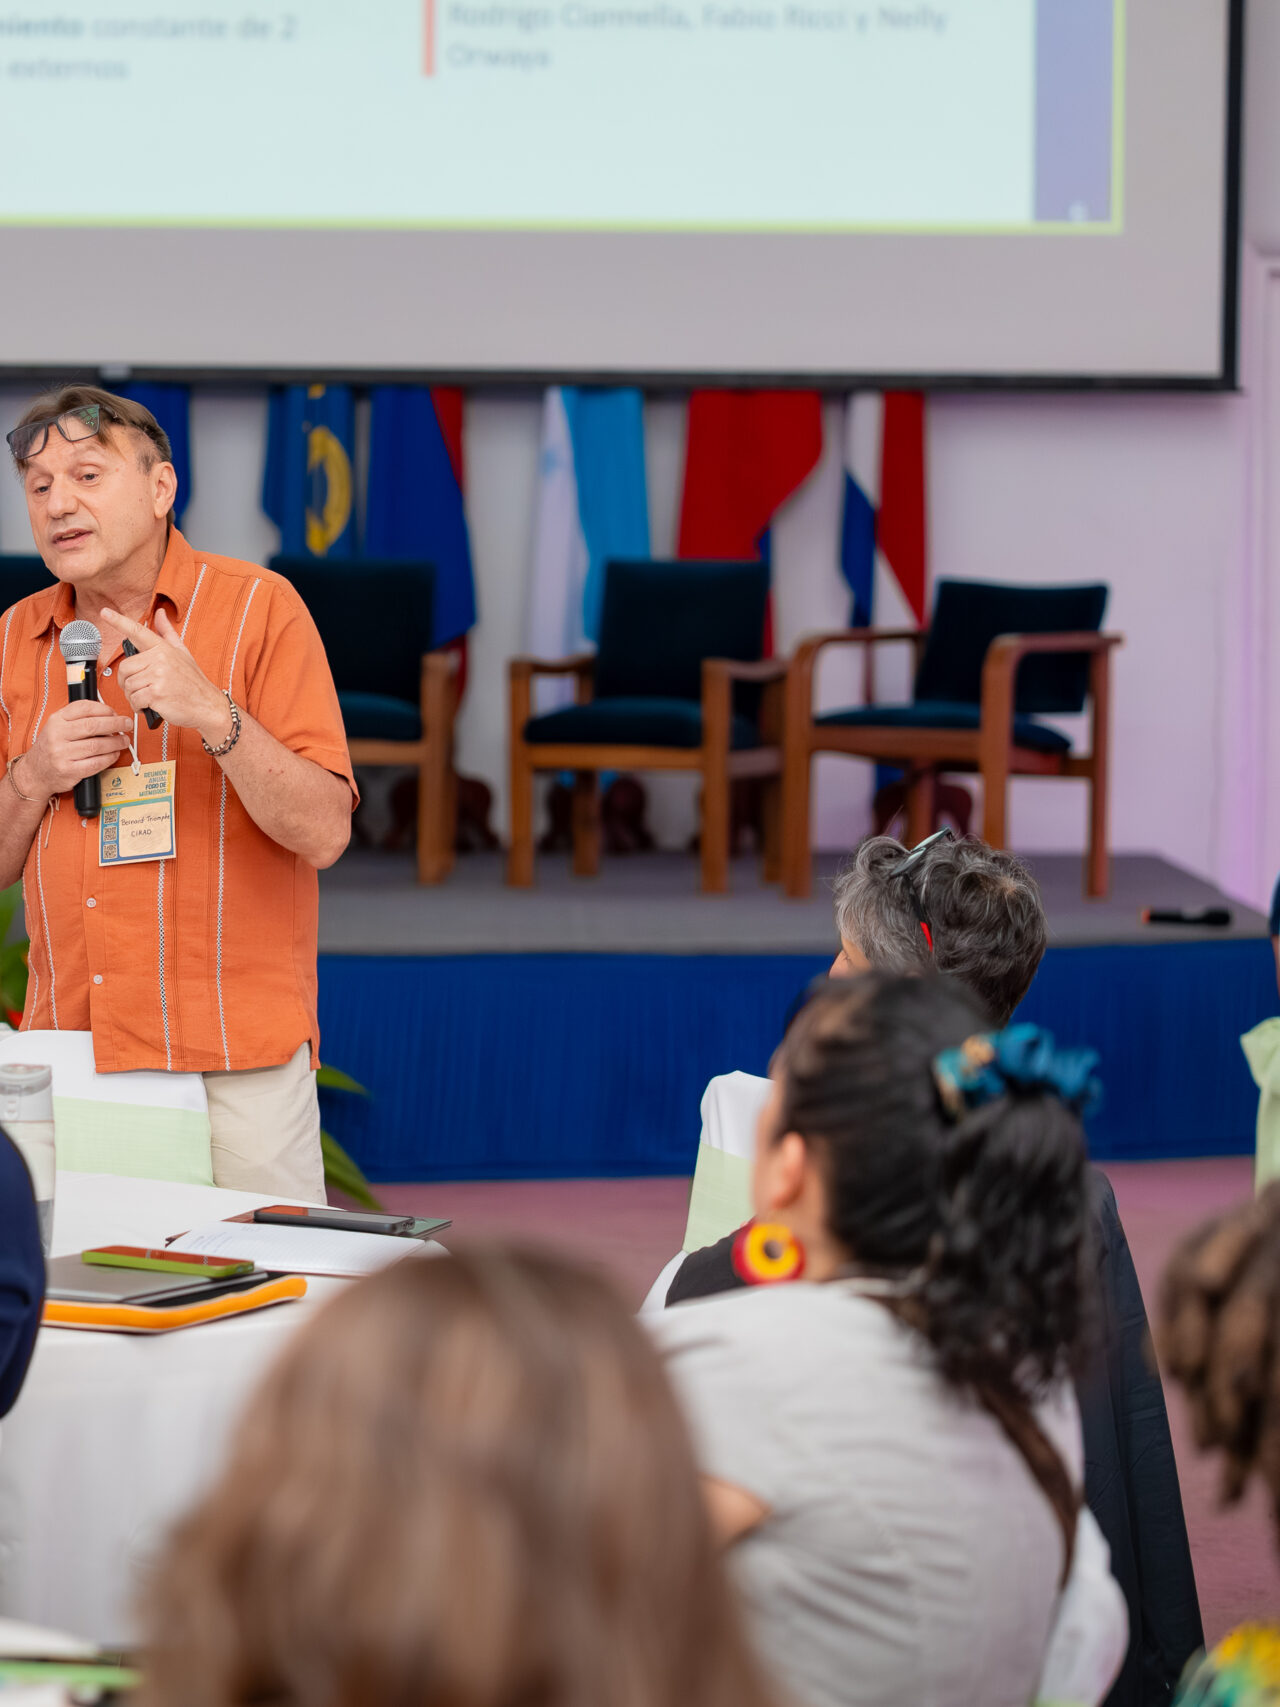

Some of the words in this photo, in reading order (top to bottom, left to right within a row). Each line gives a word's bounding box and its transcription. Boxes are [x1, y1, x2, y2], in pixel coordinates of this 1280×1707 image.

[92, 14, 228, 38] constante
[236, 12, 274, 39] de
[278, 12, 299, 41] 2
[855, 12, 868, 36] y
[8, 56, 131, 79] externos
[144, 769, 167, 778] REUNIÓN
[131, 829, 152, 837] CIRAD
